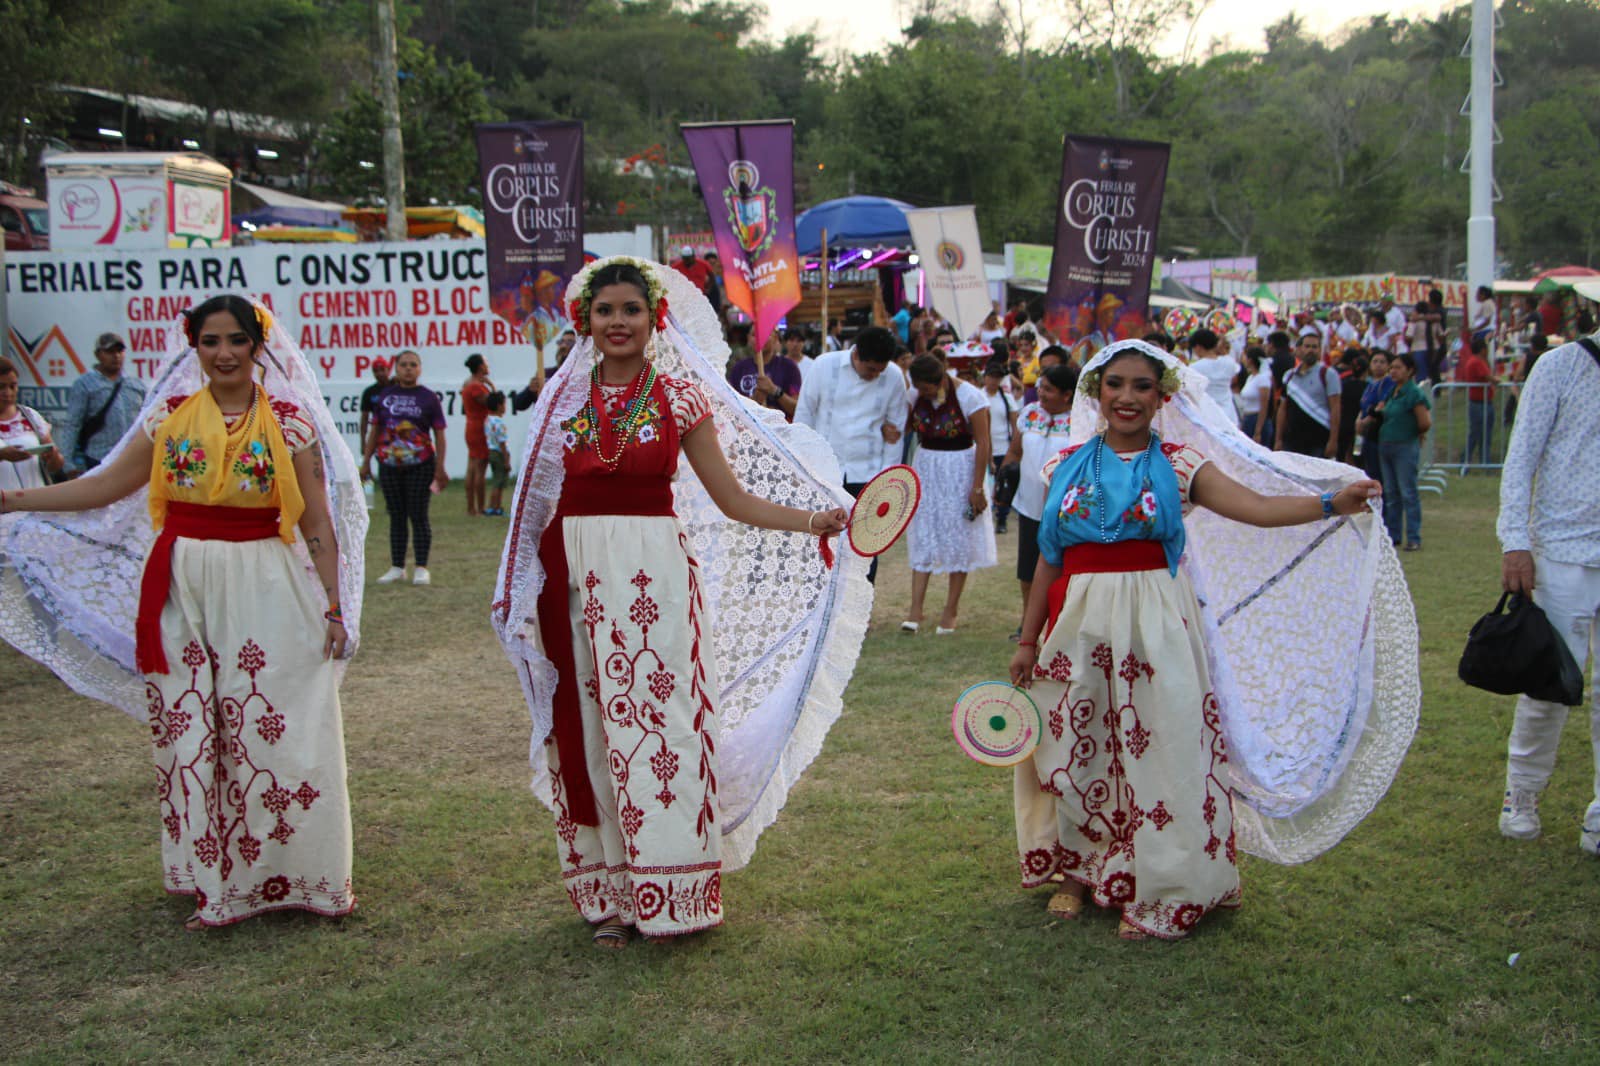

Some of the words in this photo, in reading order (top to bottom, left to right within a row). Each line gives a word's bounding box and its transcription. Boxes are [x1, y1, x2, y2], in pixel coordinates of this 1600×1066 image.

[487, 164, 560, 213] CORPUS
[1064, 179, 1136, 229] CORPUS
[1124, 182, 1136, 193] DE
[512, 195, 577, 243] CHRISTI
[1084, 213, 1151, 264] CHRISTI
[160, 257, 247, 290] PARA
[1121, 252, 1146, 266] 2024
[1310, 279, 1380, 303] FRESA
[319, 356, 335, 379] Y
